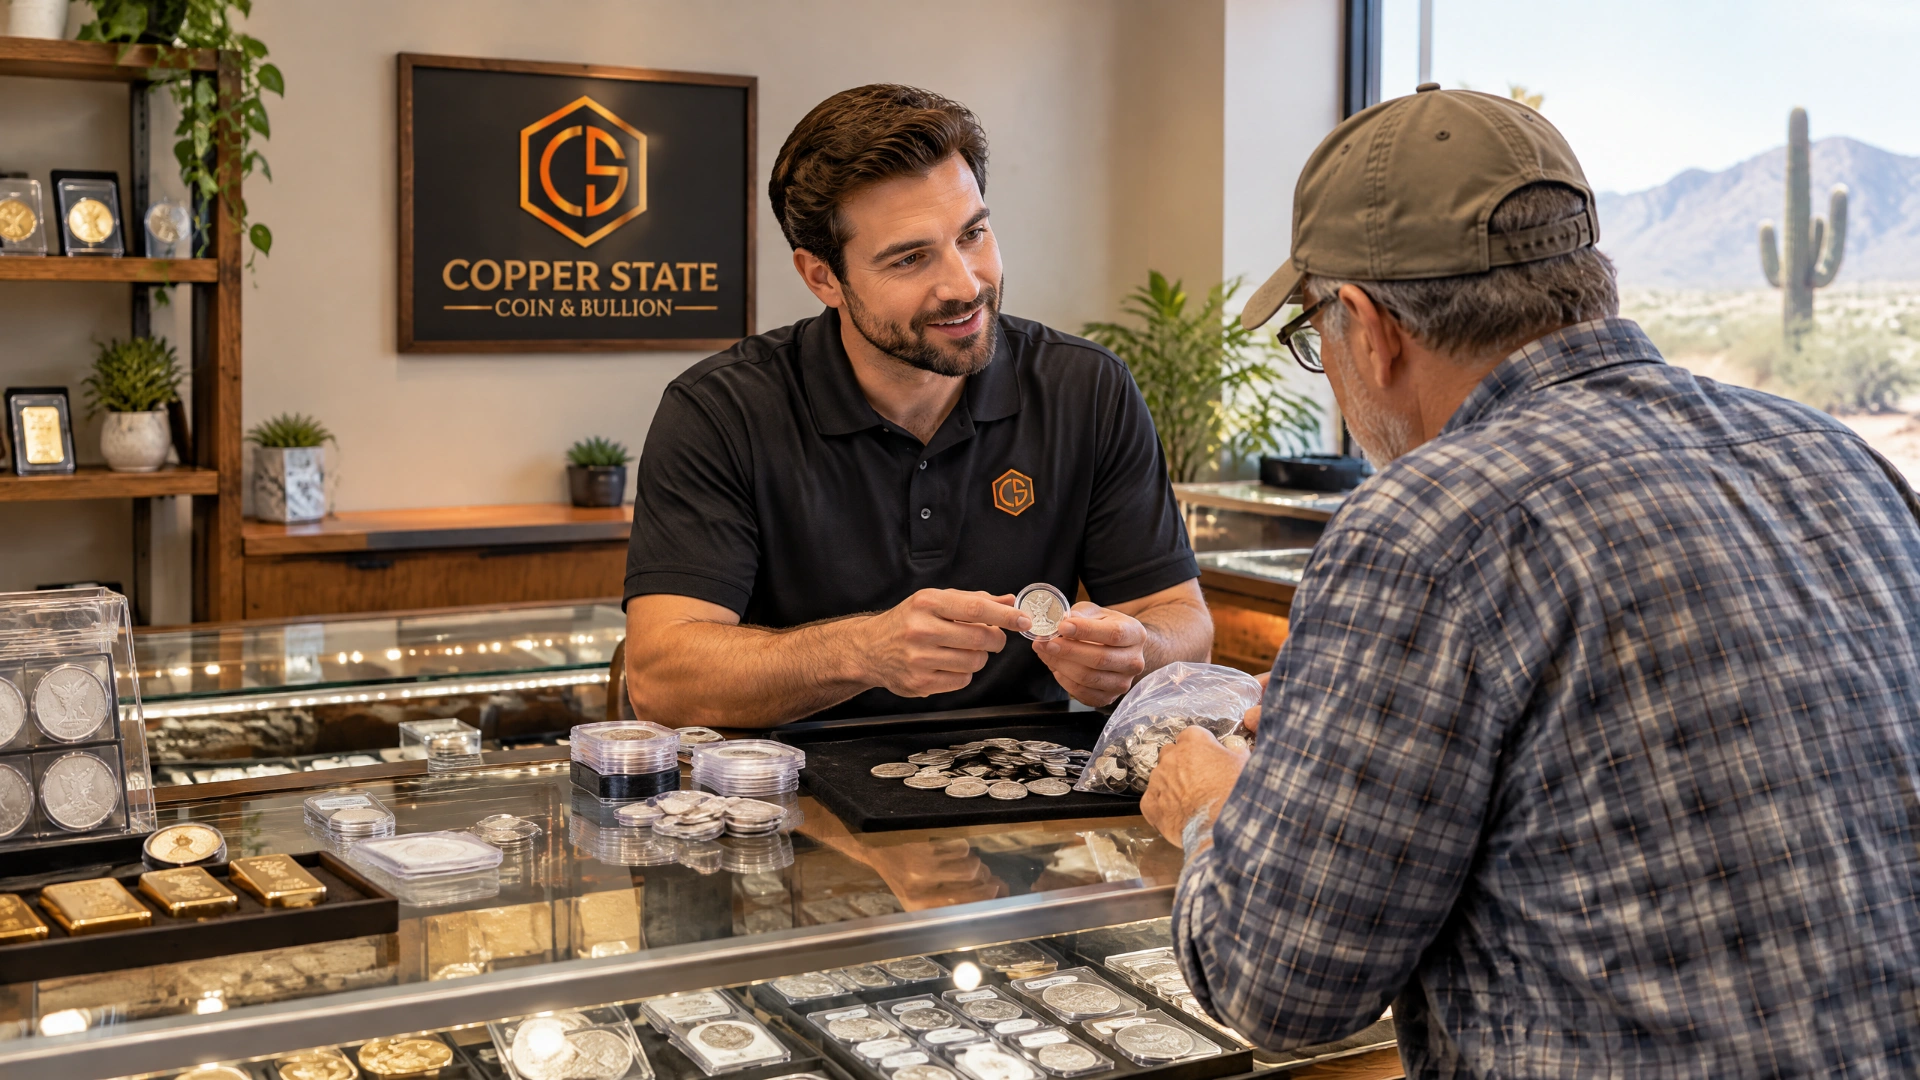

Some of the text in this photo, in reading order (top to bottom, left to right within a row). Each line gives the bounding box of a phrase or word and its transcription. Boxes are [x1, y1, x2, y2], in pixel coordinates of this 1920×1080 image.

[442, 259, 718, 291] COPPER STATE
[495, 299, 672, 317] COIN & BULLION
